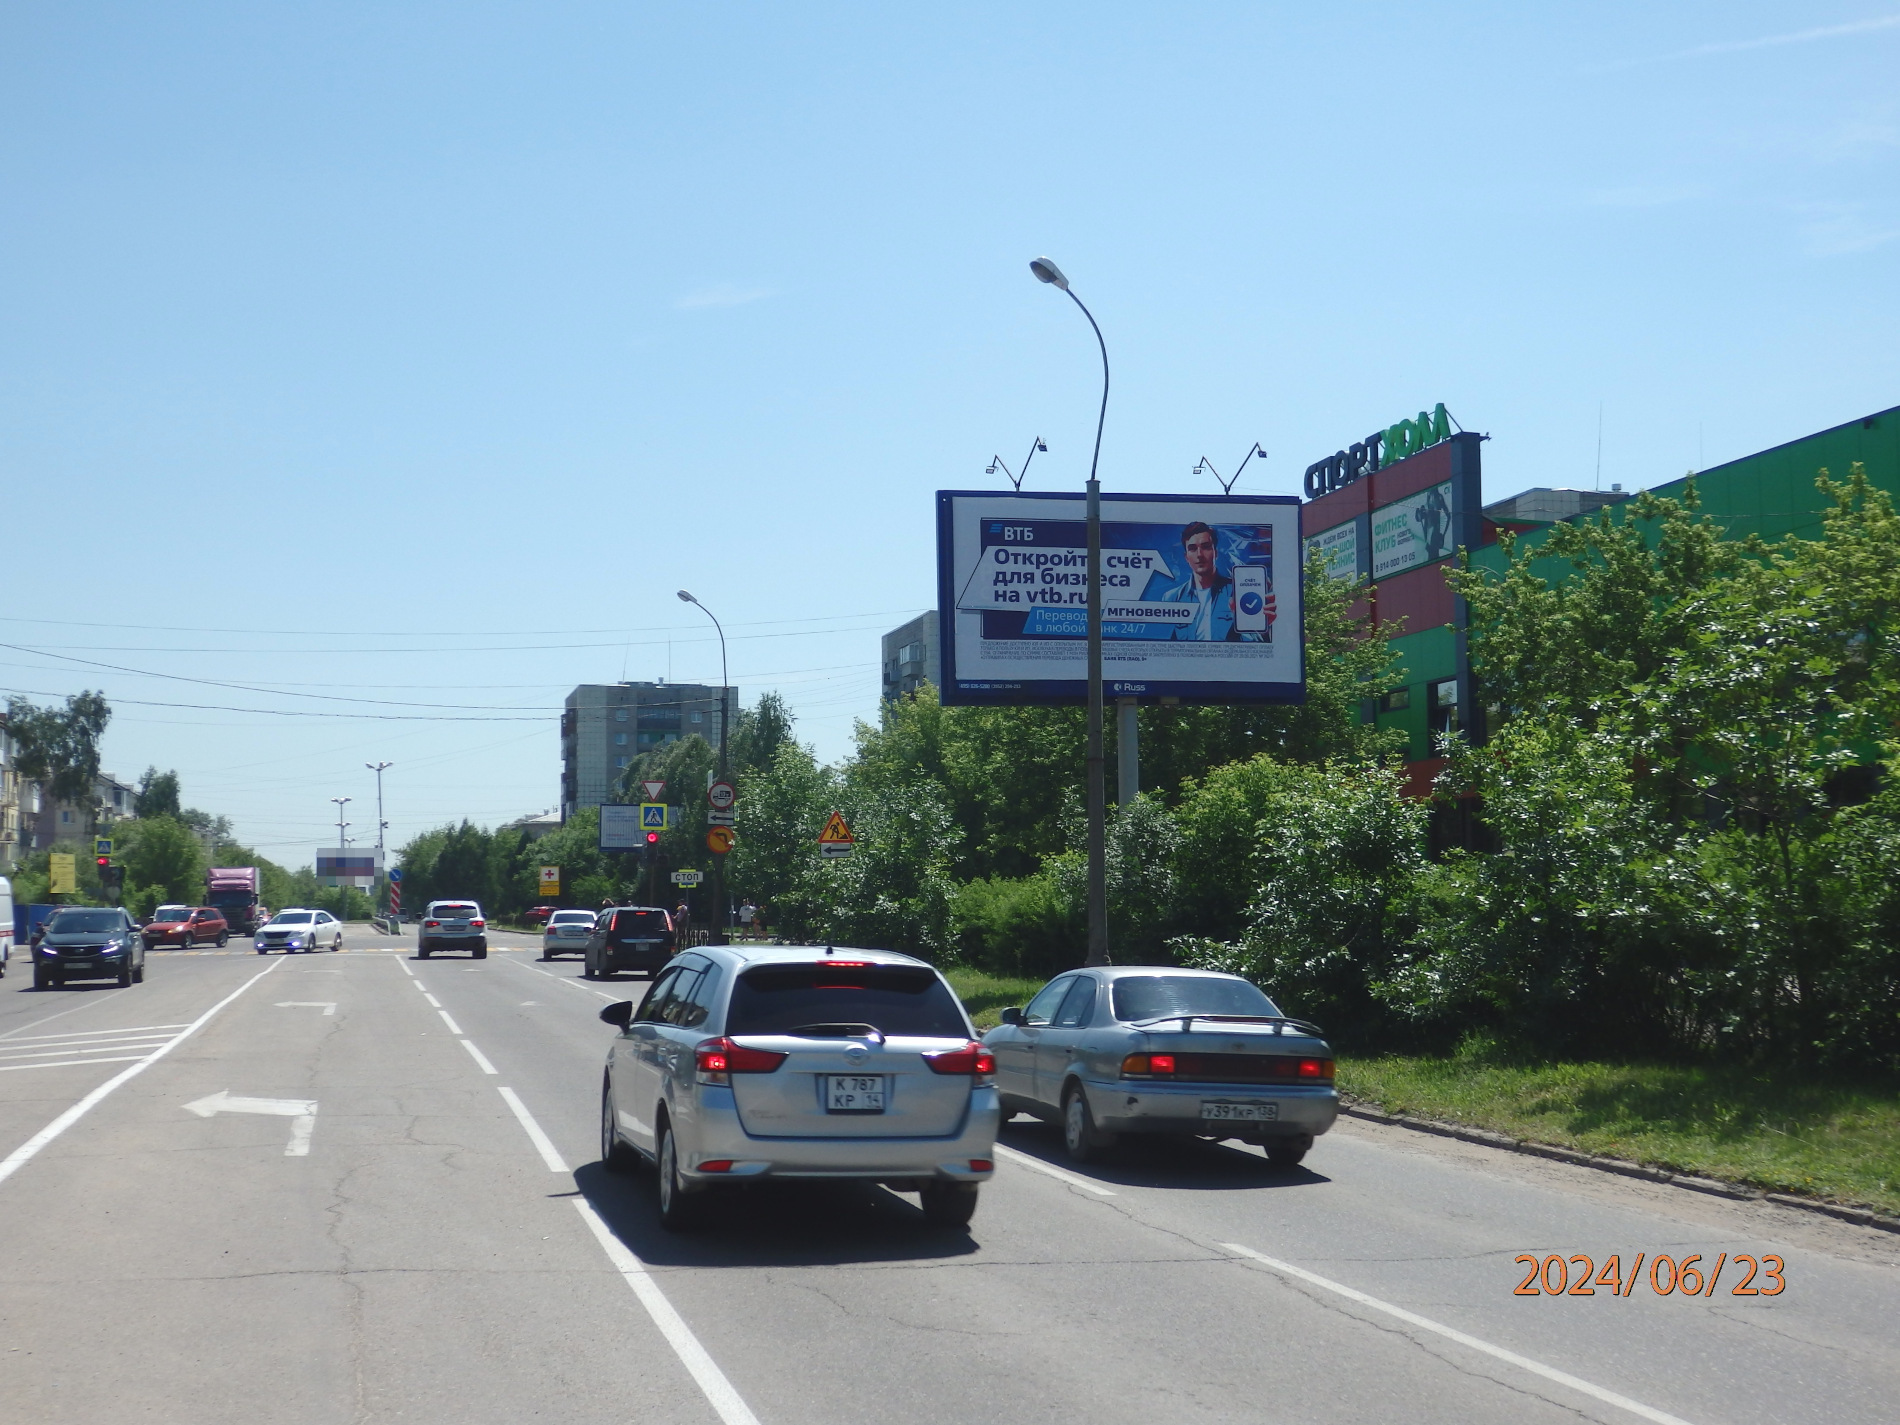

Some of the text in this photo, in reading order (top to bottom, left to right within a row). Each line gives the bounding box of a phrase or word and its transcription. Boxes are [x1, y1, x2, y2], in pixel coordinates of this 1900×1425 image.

[1374, 513, 1408, 537] ФИТНЕС
[1004, 526, 1034, 541] ВТБ
[1375, 534, 1396, 554] КЛУБ
[994, 548, 1153, 569] Откройт счёт
[993, 570, 1034, 586] для
[994, 586, 1088, 604] на vtb.ru
[1036, 606, 1191, 622] Перевод мгновенно
[1045, 622, 1086, 633] любой
[1101, 624, 1117, 633] нк
[1121, 623, 1146, 634] 24/7
[1124, 682, 1146, 691] Russ
[675, 873, 699, 881] СТОП
[851, 1078, 876, 1091] 787
[834, 1094, 855, 1107] КР
